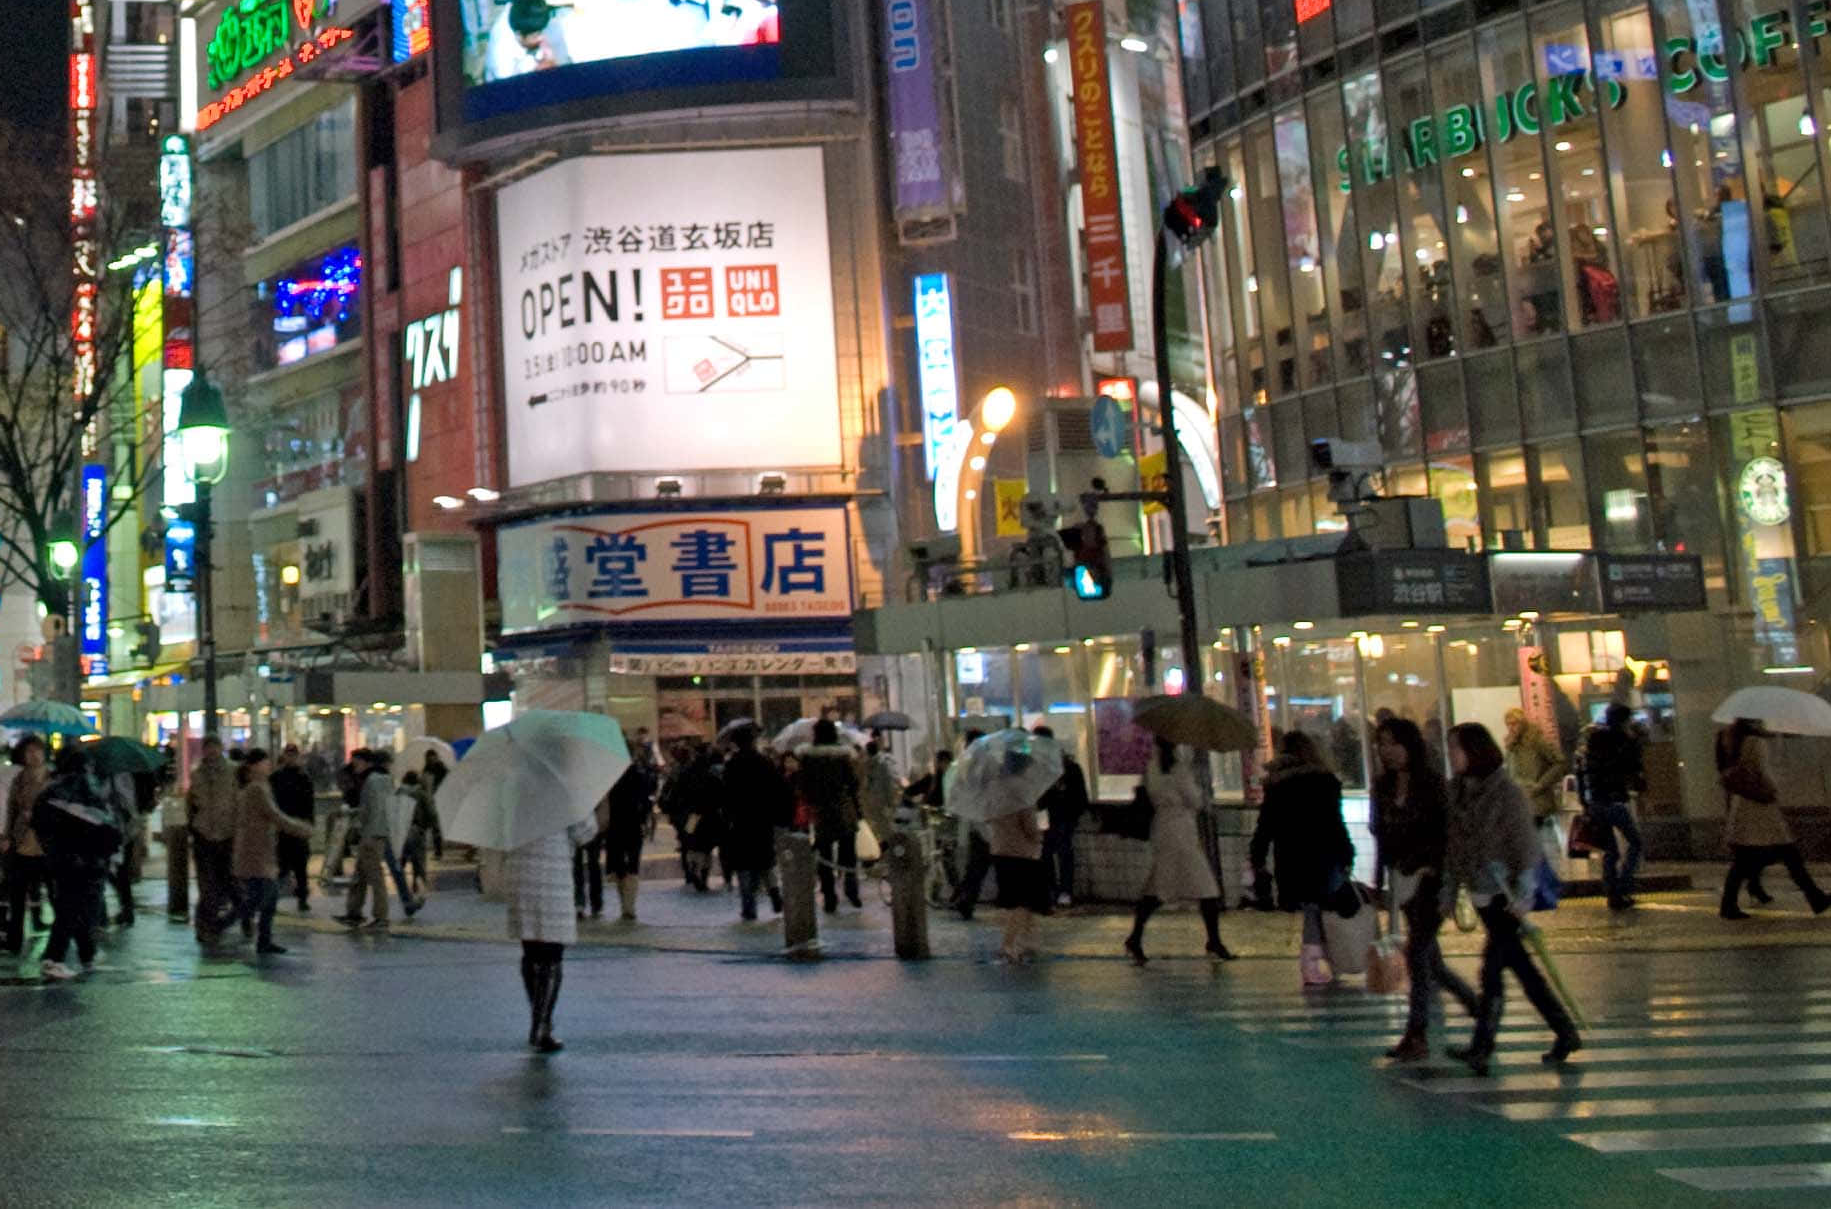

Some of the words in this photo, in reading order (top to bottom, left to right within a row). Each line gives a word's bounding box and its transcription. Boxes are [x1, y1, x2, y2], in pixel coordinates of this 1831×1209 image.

[1336, 71, 1624, 195] STARBUCKS
[584, 221, 776, 256] 渋谷道玄坂店
[728, 269, 771, 291] UNI
[521, 268, 645, 341] OPEN!
[730, 291, 777, 314] QLO
